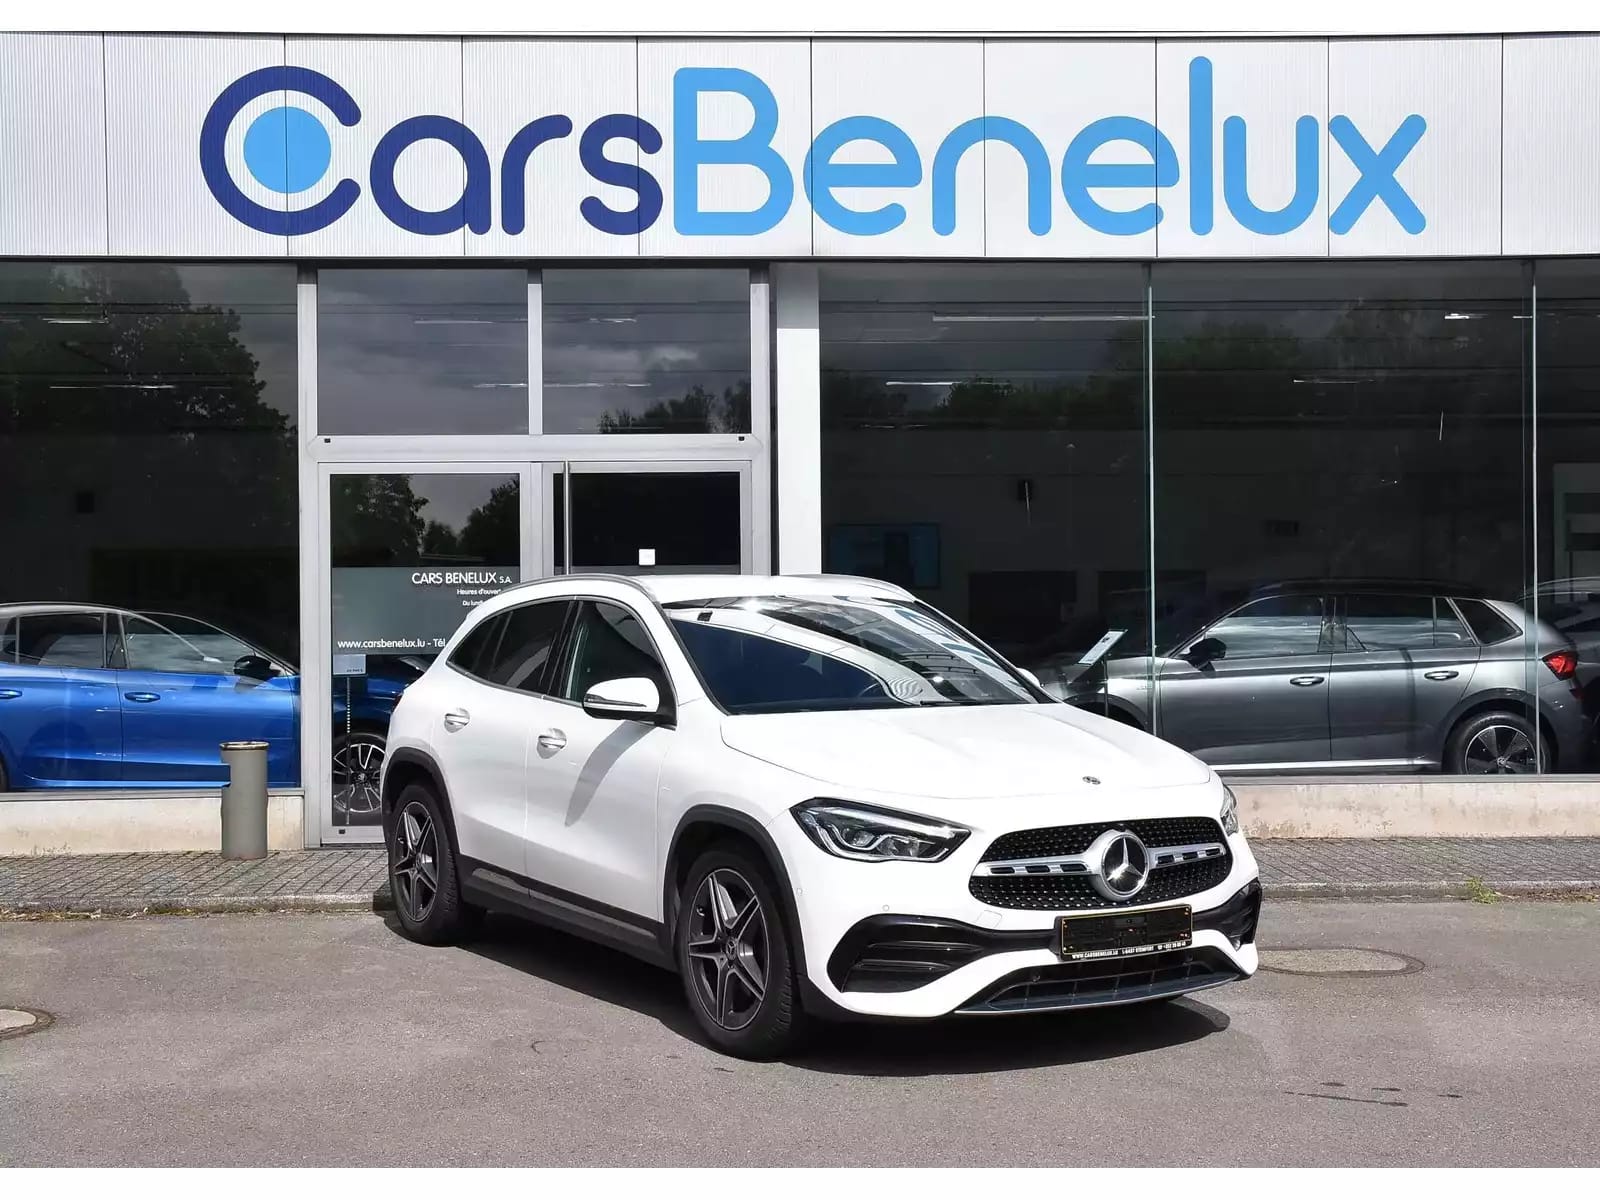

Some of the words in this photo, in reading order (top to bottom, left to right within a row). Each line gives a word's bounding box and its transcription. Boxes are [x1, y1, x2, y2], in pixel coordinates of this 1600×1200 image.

[411, 572, 443, 584] CARS
[445, 572, 497, 584] BENELUX
[337, 637, 426, 648] www.carsbenelux.lu
